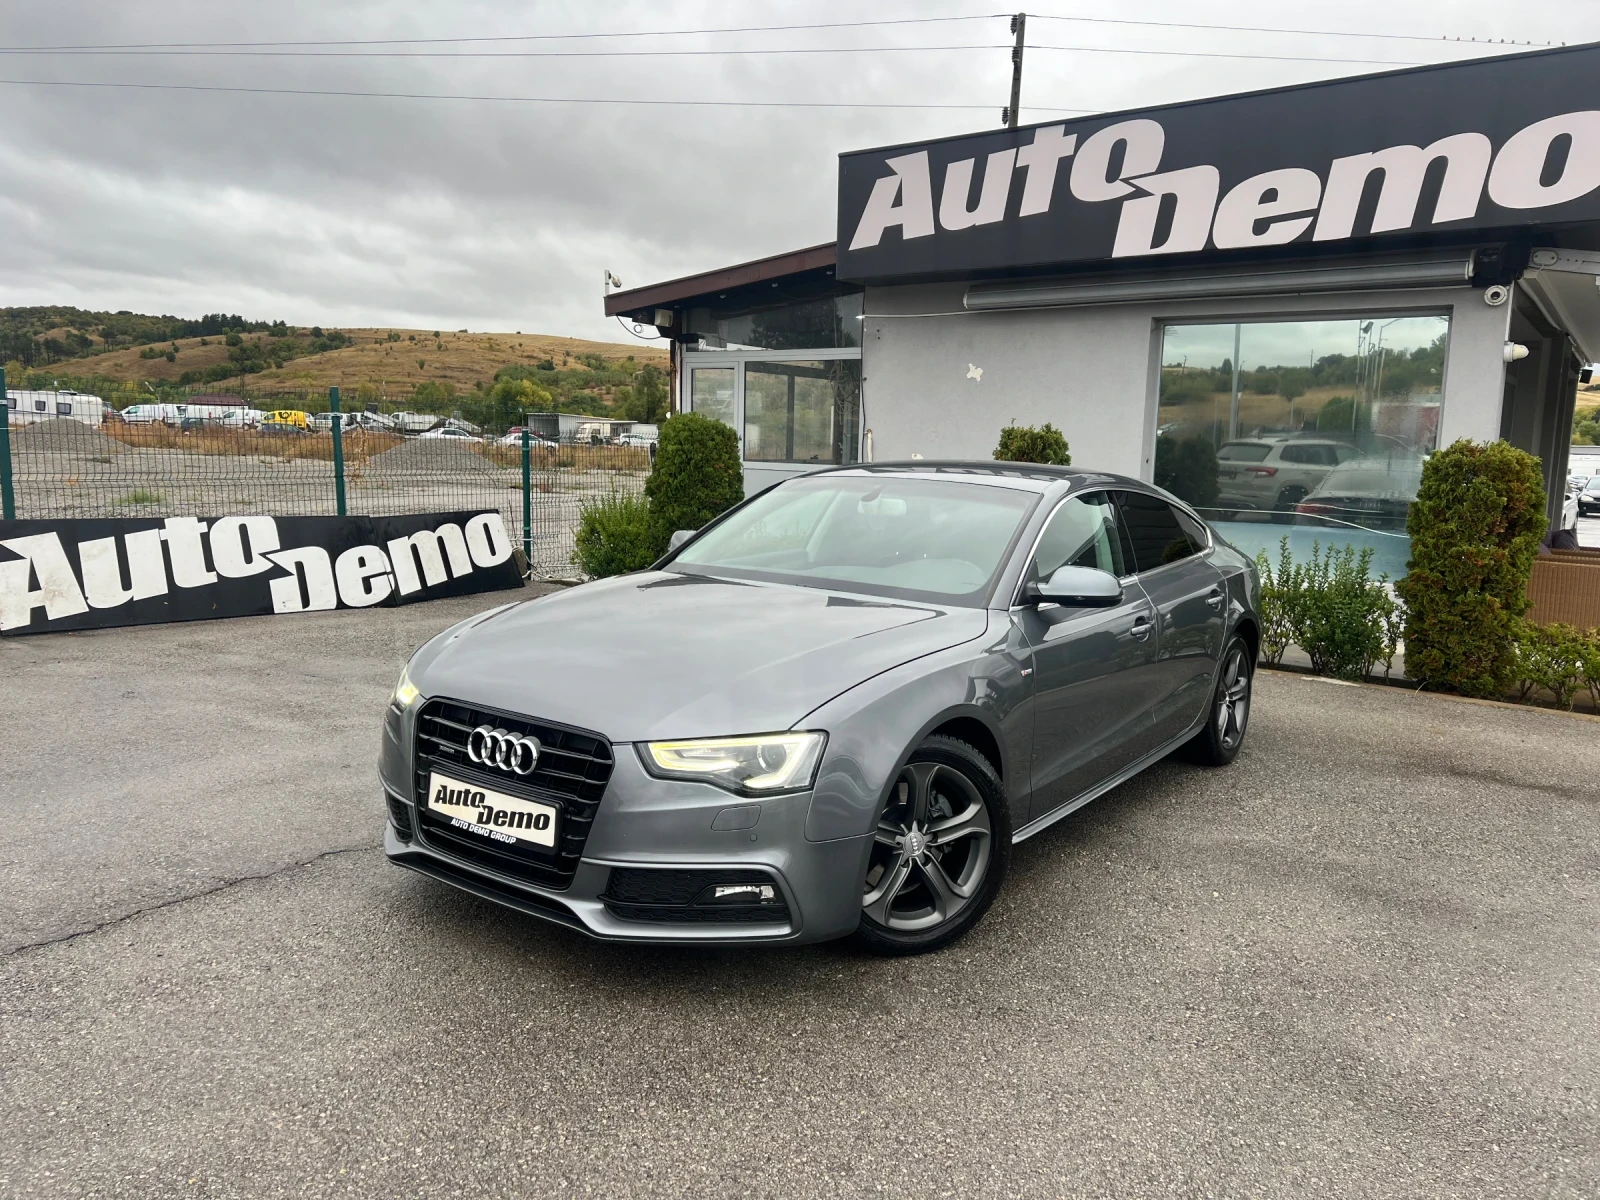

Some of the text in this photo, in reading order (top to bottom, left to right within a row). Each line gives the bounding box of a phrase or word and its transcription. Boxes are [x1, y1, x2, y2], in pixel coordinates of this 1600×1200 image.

[849, 110, 1600, 258] Auto Demo
[0, 513, 512, 630] Auto Demo
[433, 784, 550, 831] Auto Demo
[450, 817, 517, 845] AUTO DEMO GROUP
